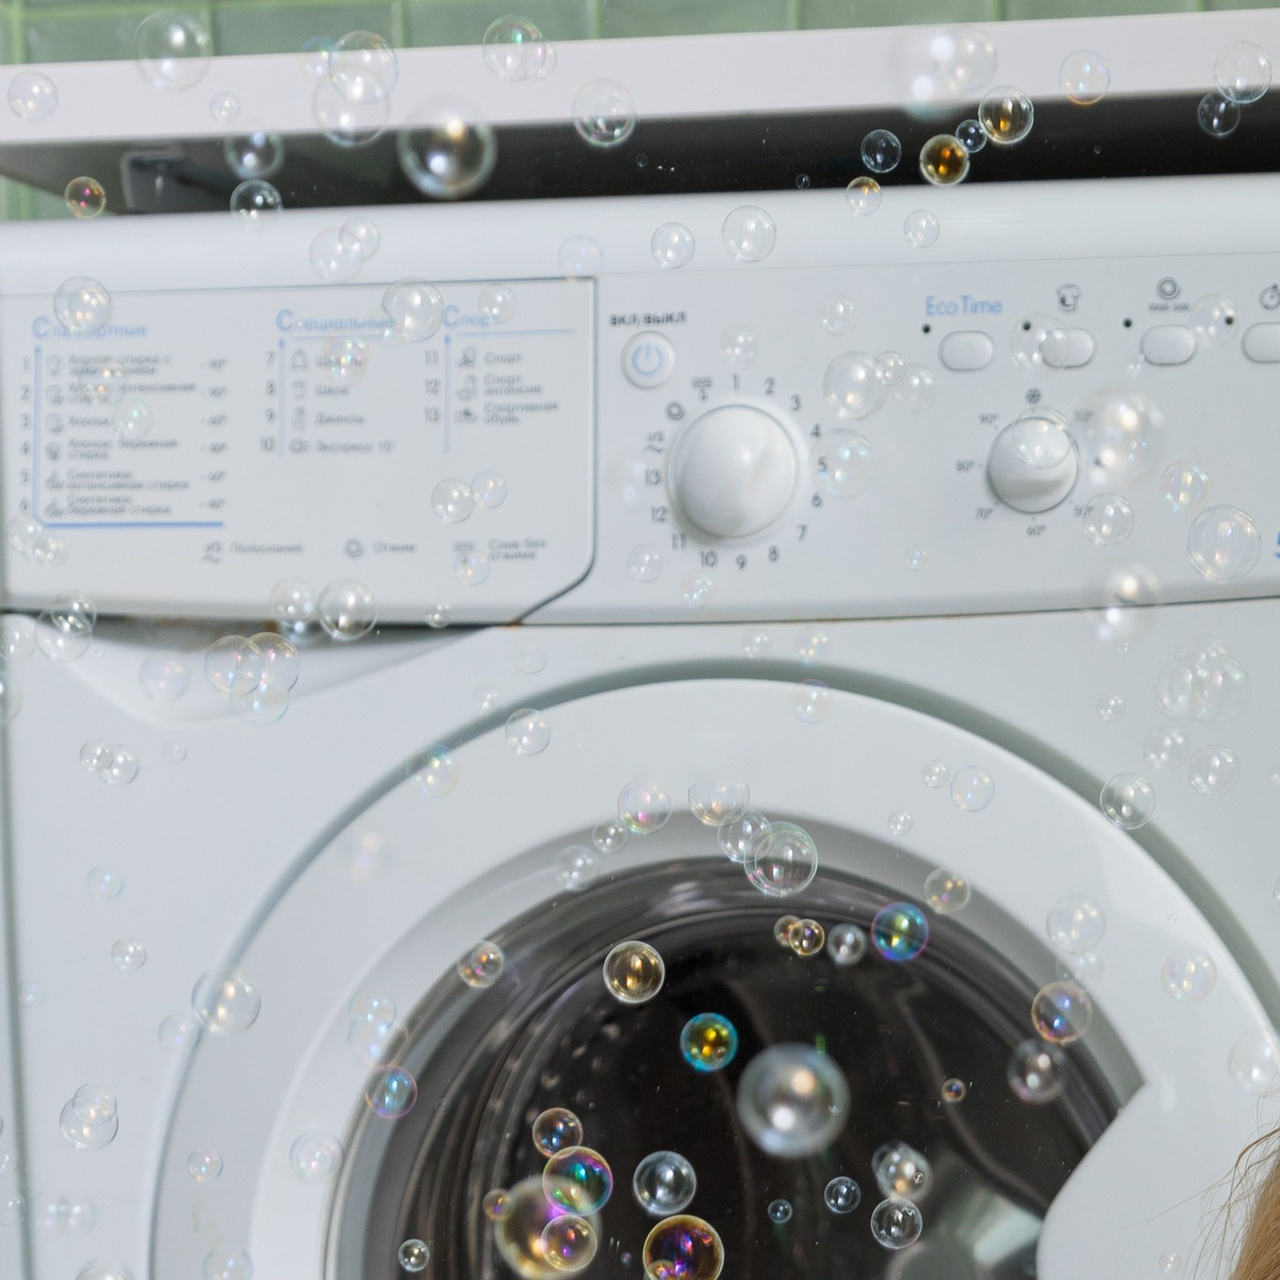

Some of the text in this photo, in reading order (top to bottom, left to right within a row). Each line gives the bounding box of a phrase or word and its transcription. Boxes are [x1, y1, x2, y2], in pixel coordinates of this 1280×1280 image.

[925, 294, 1003, 316] Eco Time
[732, 373, 739, 390] 1
[764, 377, 776, 394] 2
[790, 395, 801, 411] 3
[810, 423, 821, 438] 4
[817, 457, 827, 472] 5
[645, 468, 661, 485] 13
[811, 493, 823, 507] 6
[651, 505, 668, 522] 12
[797, 524, 808, 540] 7
[671, 533, 687, 550] 11
[701, 550, 718, 567] 10
[736, 554, 747, 570] 9
[768, 545, 779, 562] 8
